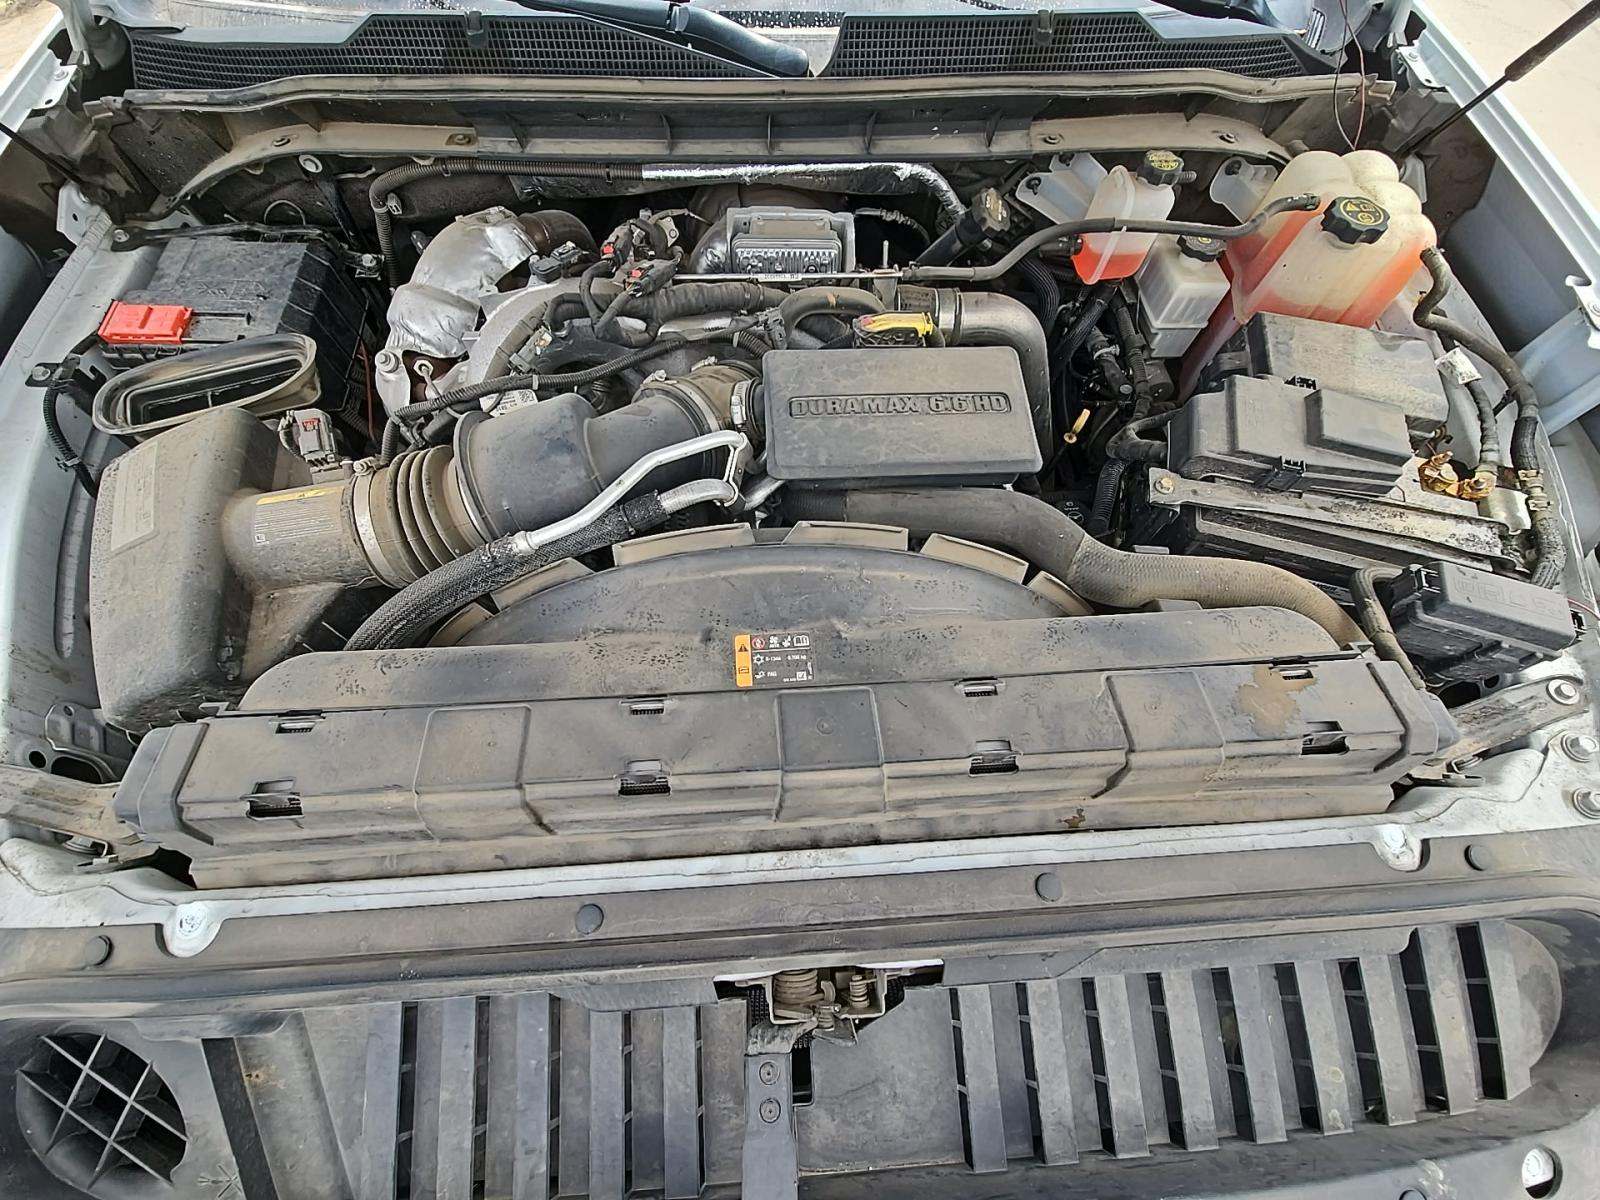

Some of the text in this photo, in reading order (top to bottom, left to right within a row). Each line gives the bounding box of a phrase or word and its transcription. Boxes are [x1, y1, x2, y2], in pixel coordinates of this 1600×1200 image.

[791, 395, 1008, 416] DURAMAX 6.6 HD
